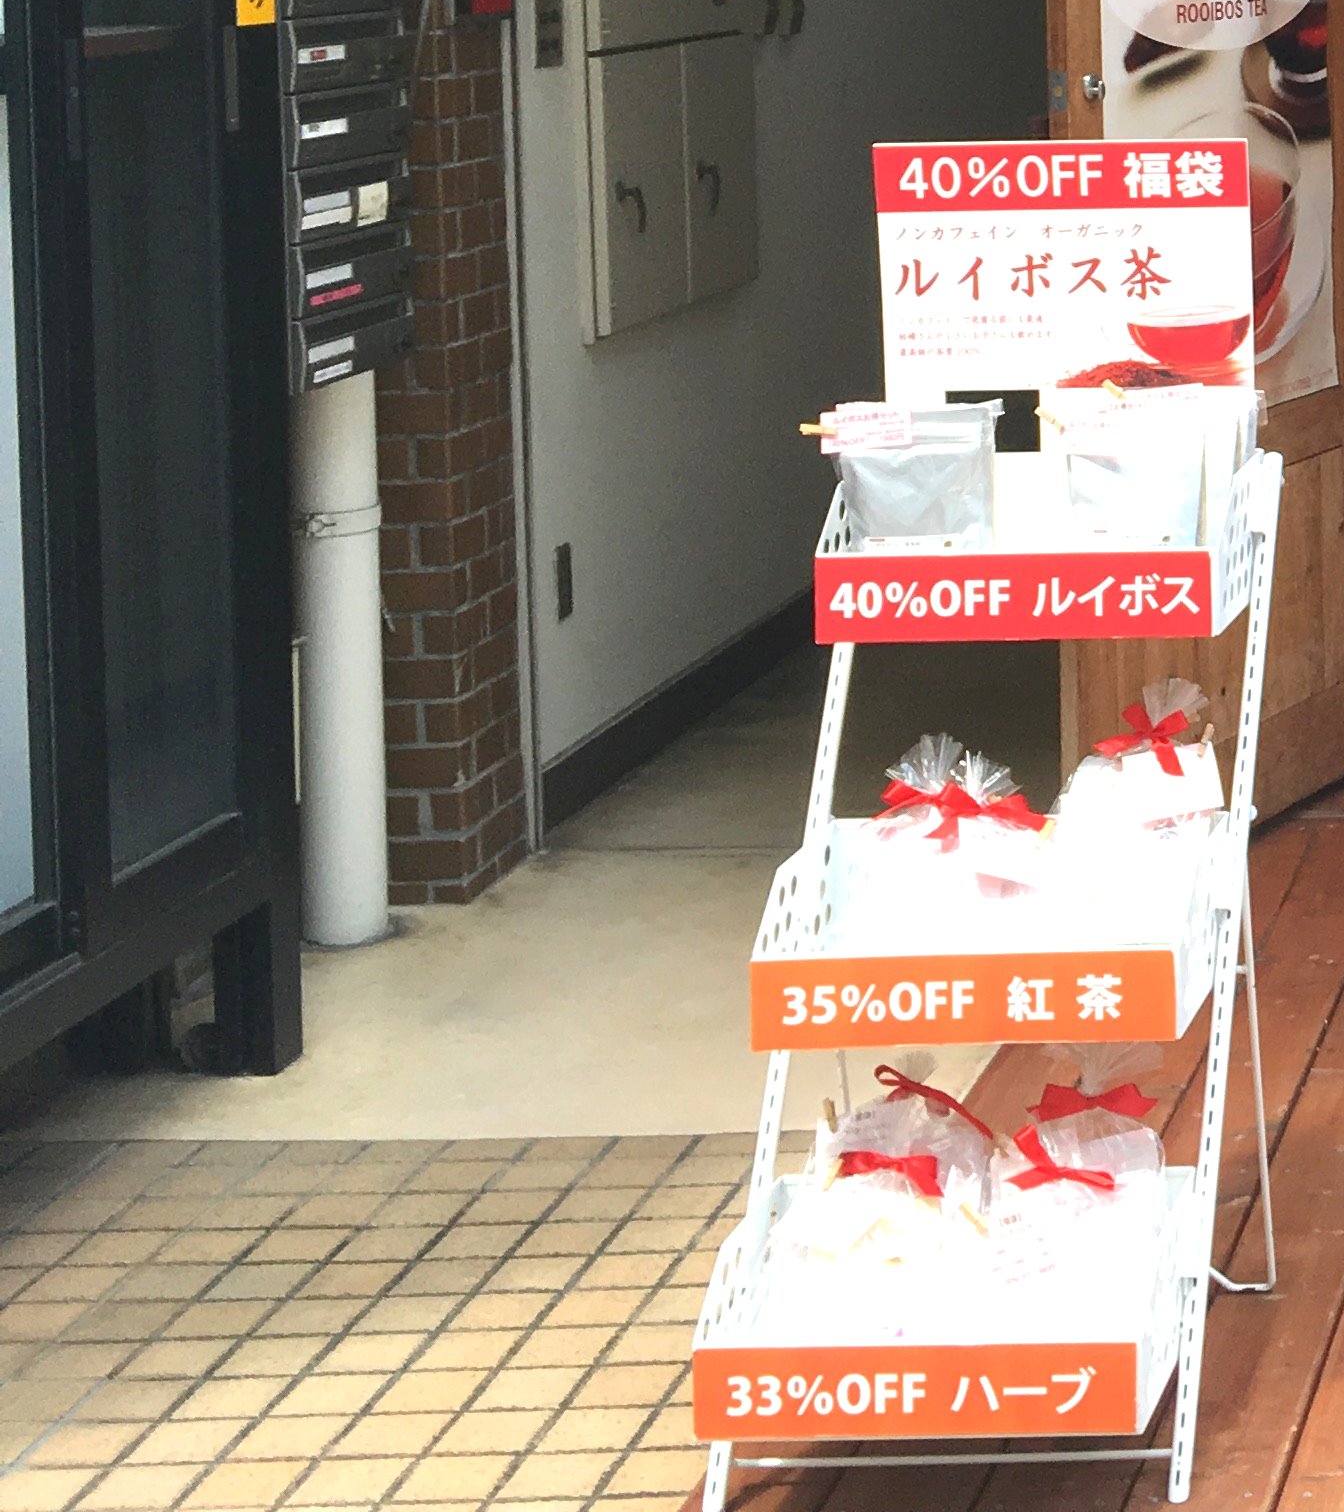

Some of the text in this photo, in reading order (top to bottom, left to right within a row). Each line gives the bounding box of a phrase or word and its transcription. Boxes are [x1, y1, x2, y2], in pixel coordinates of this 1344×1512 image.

[1176, 0, 1244, 24] ROOIBOS
[899, 150, 1225, 200] 40%OFF 福袋
[894, 246, 1173, 302] ルイボス茶
[829, 572, 1201, 619] 40%OFF ルイボス
[781, 973, 1124, 1026] 35%OFF 紅茶
[725, 1365, 1097, 1417] 33%OFF ハーブ
